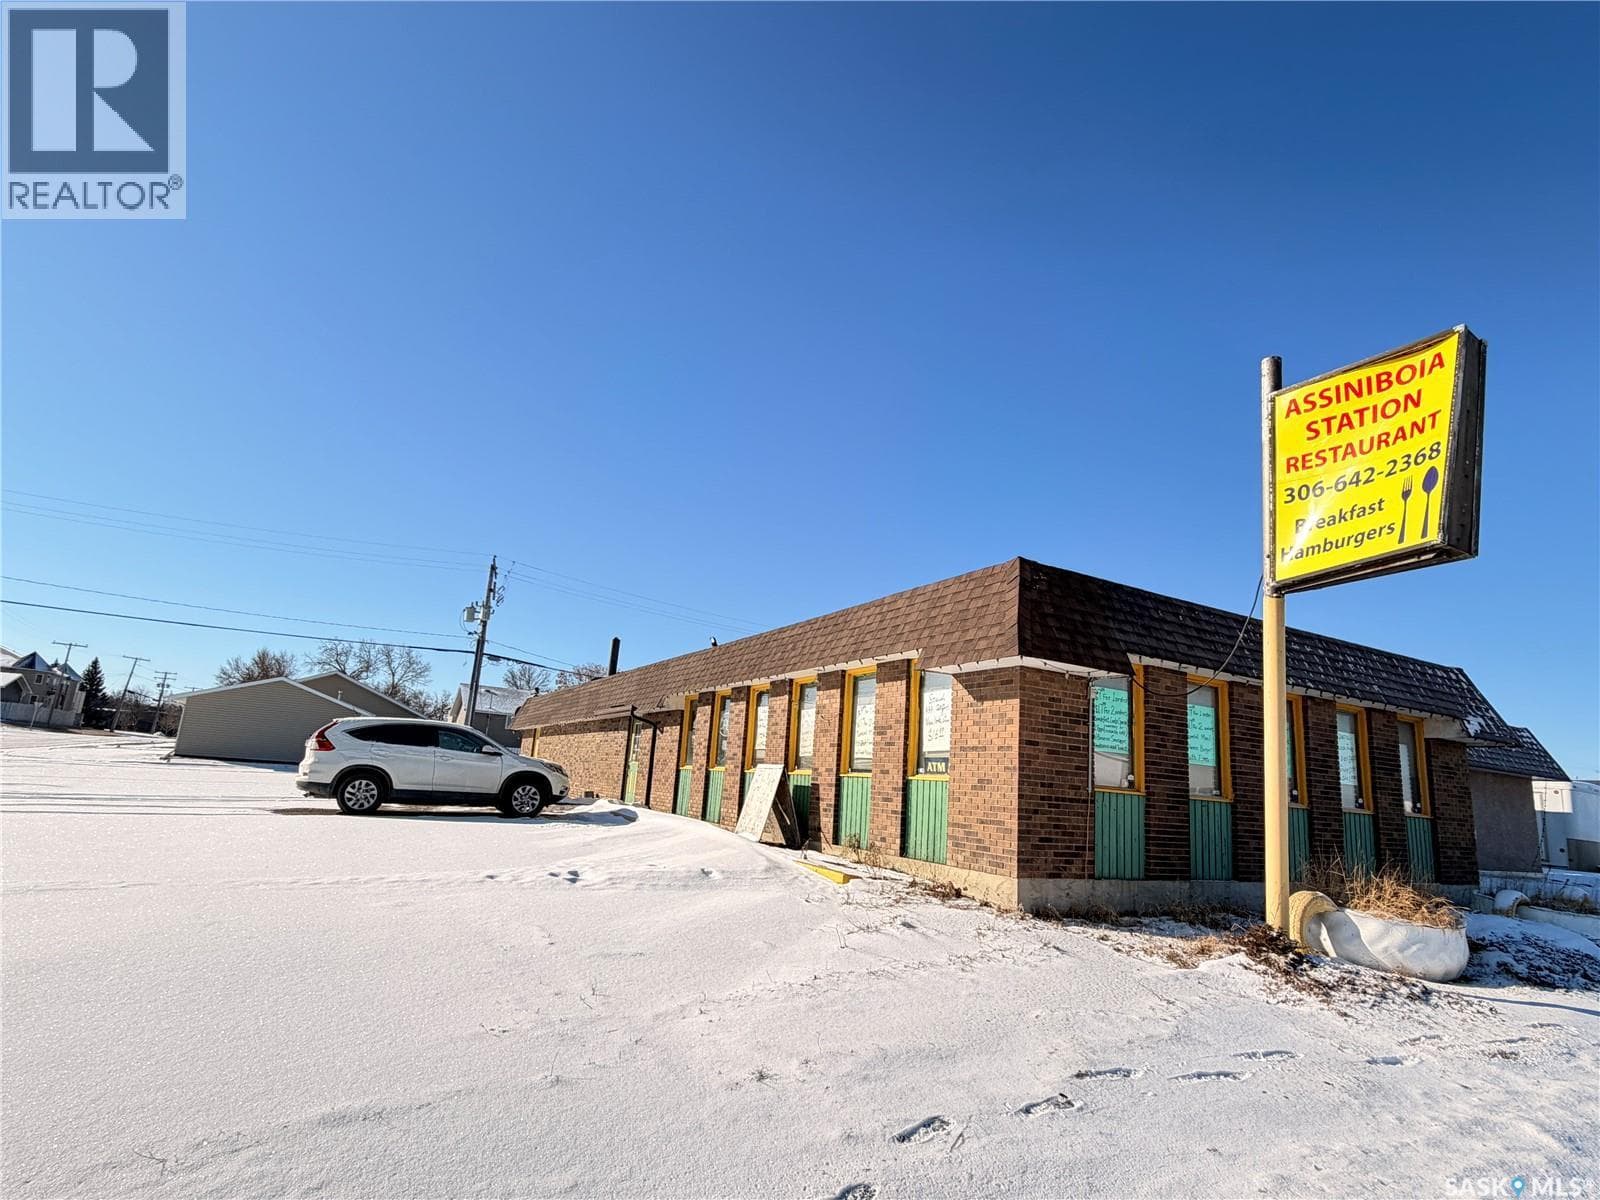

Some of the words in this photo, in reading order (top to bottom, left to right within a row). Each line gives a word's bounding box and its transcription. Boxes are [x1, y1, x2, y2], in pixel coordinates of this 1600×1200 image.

[1285, 352, 1445, 419] ASSINIBOIA
[1306, 389, 1423, 441] STATION
[1286, 409, 1442, 474] RESTAURANT
[1284, 441, 1442, 504] 306-642-2368
[1295, 497, 1385, 534] Beakfast
[1281, 521, 1396, 563] Hamburgers
[927, 762, 946, 773] ATM
